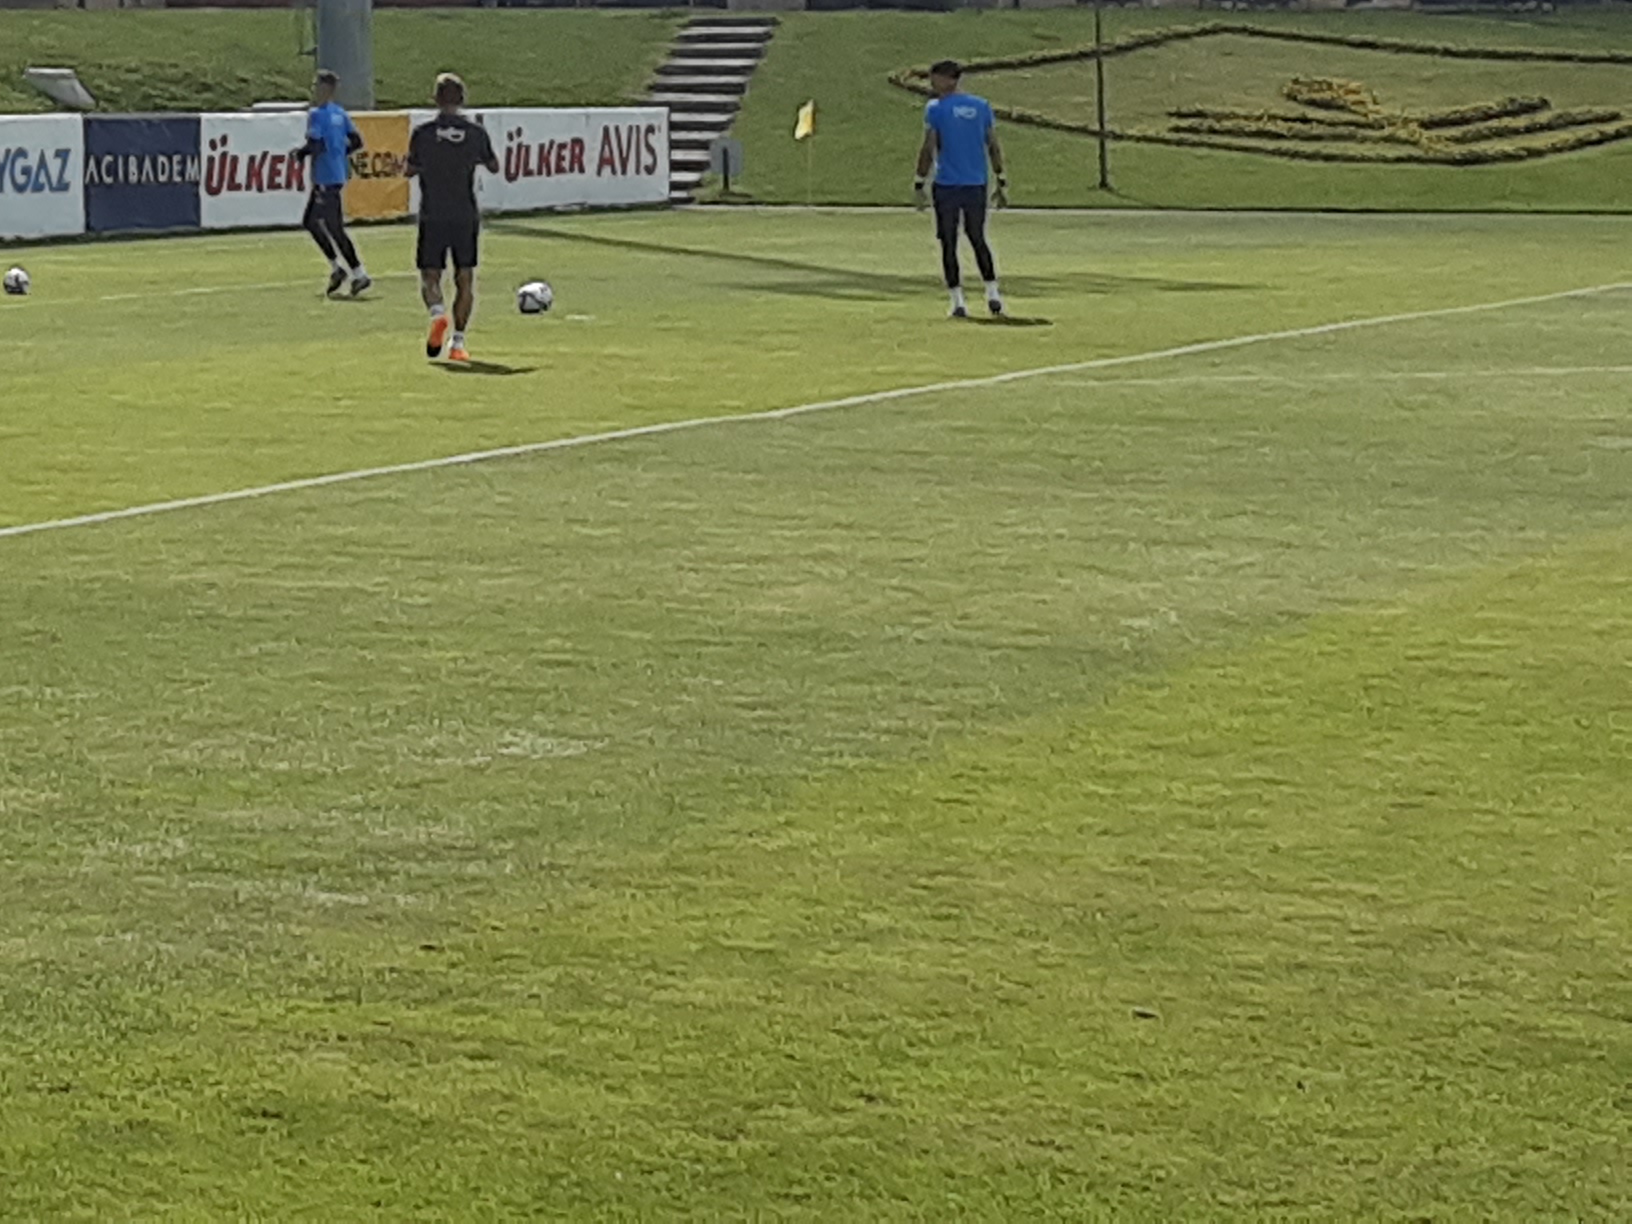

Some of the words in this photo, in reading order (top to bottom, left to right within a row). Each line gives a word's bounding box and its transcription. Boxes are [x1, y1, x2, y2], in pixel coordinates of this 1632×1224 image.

[85, 154, 199, 184] ACIBADEM
[205, 134, 306, 196] ÜLKER
[505, 126, 586, 183] ÜLKER
[597, 124, 658, 177] AVIS
